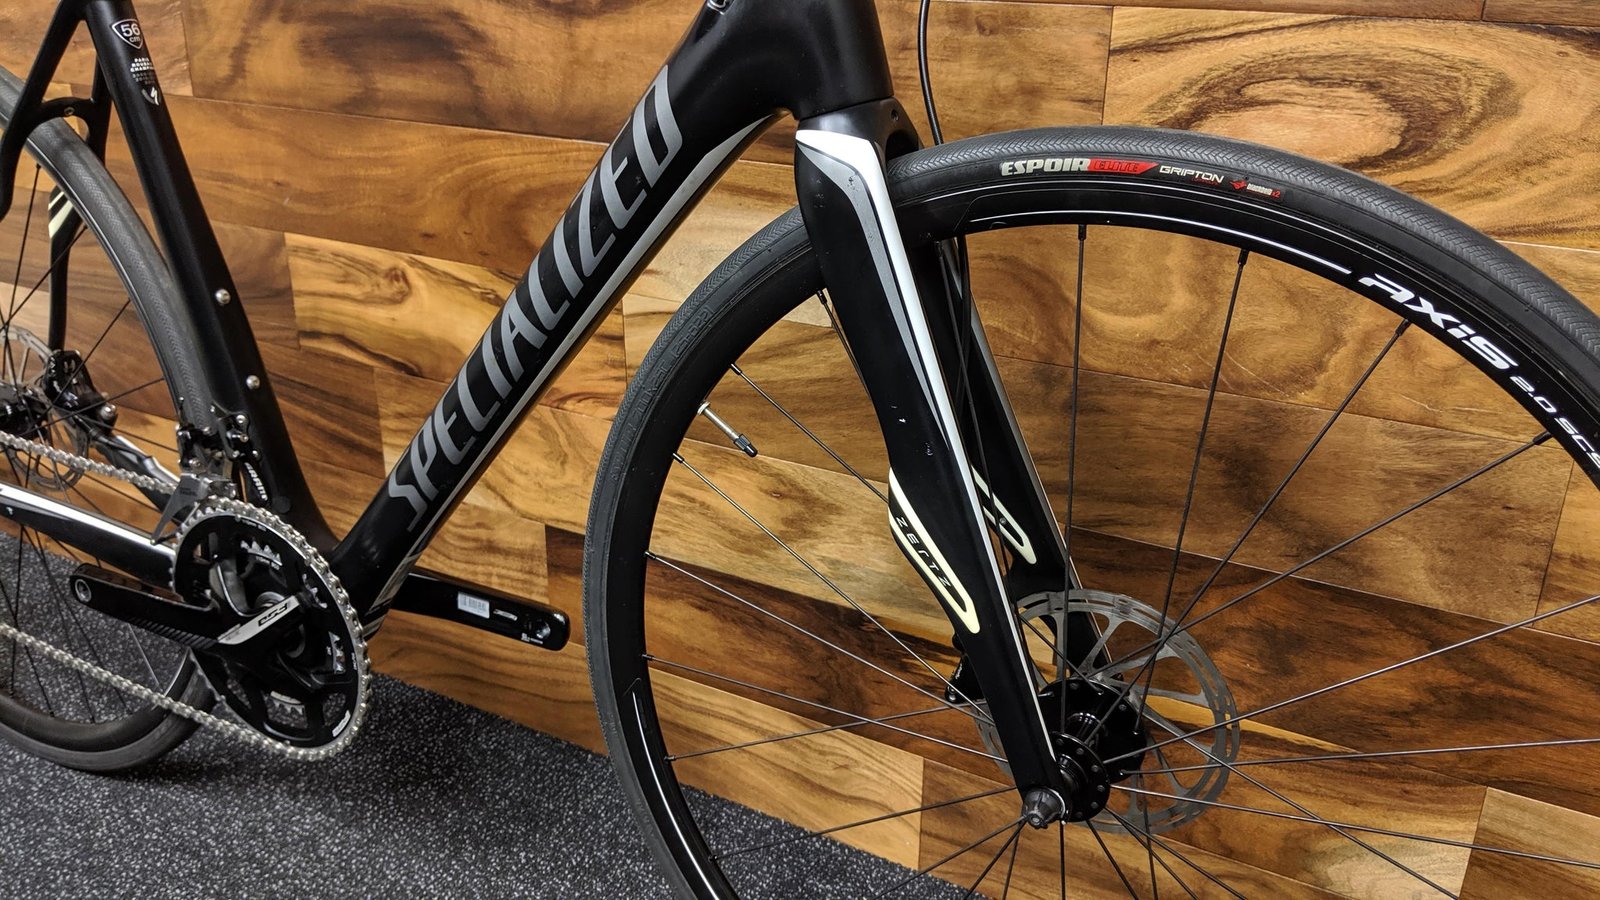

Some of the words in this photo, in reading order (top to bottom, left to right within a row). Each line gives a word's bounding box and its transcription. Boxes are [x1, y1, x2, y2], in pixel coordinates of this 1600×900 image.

[120, 23, 140, 37] 56
[1000, 157, 1090, 177] ESPOIR
[1159, 164, 1225, 184] GRIPTON
[388, 64, 683, 532] SPECIALIZED
[1509, 375, 1557, 413] 2.0
